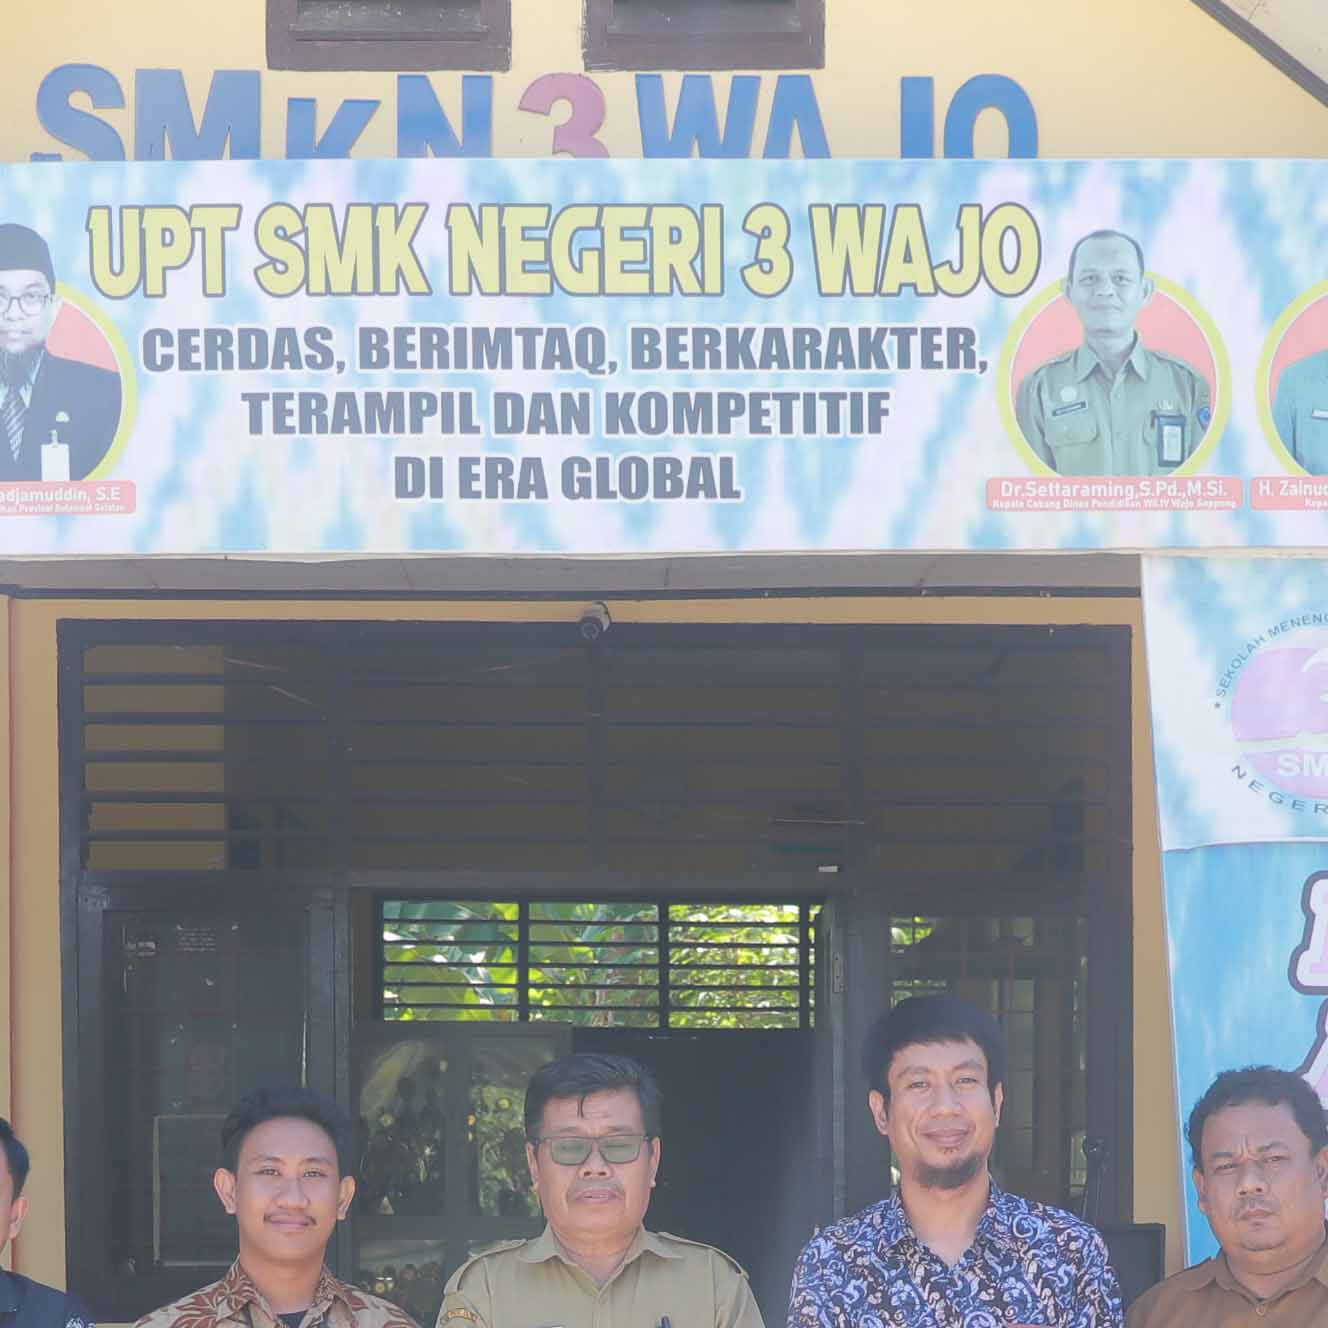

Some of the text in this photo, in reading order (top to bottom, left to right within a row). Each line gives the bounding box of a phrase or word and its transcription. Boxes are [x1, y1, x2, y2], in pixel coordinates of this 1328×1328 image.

[518, 73, 610, 159] 3
[85, 202, 1042, 300] UPT SMK NEGERI 3 WAJO
[142, 325, 989, 376] CERDAS, BERIMTAQ, BERKARAKTER,
[242, 391, 891, 436] TERAMPIL DAN KOMPETITIF
[394, 456, 741, 501] DI ERA GLOBAL
[1259, 481, 1274, 497] H.
[1215, 634, 1266, 700] SEKOLAH
